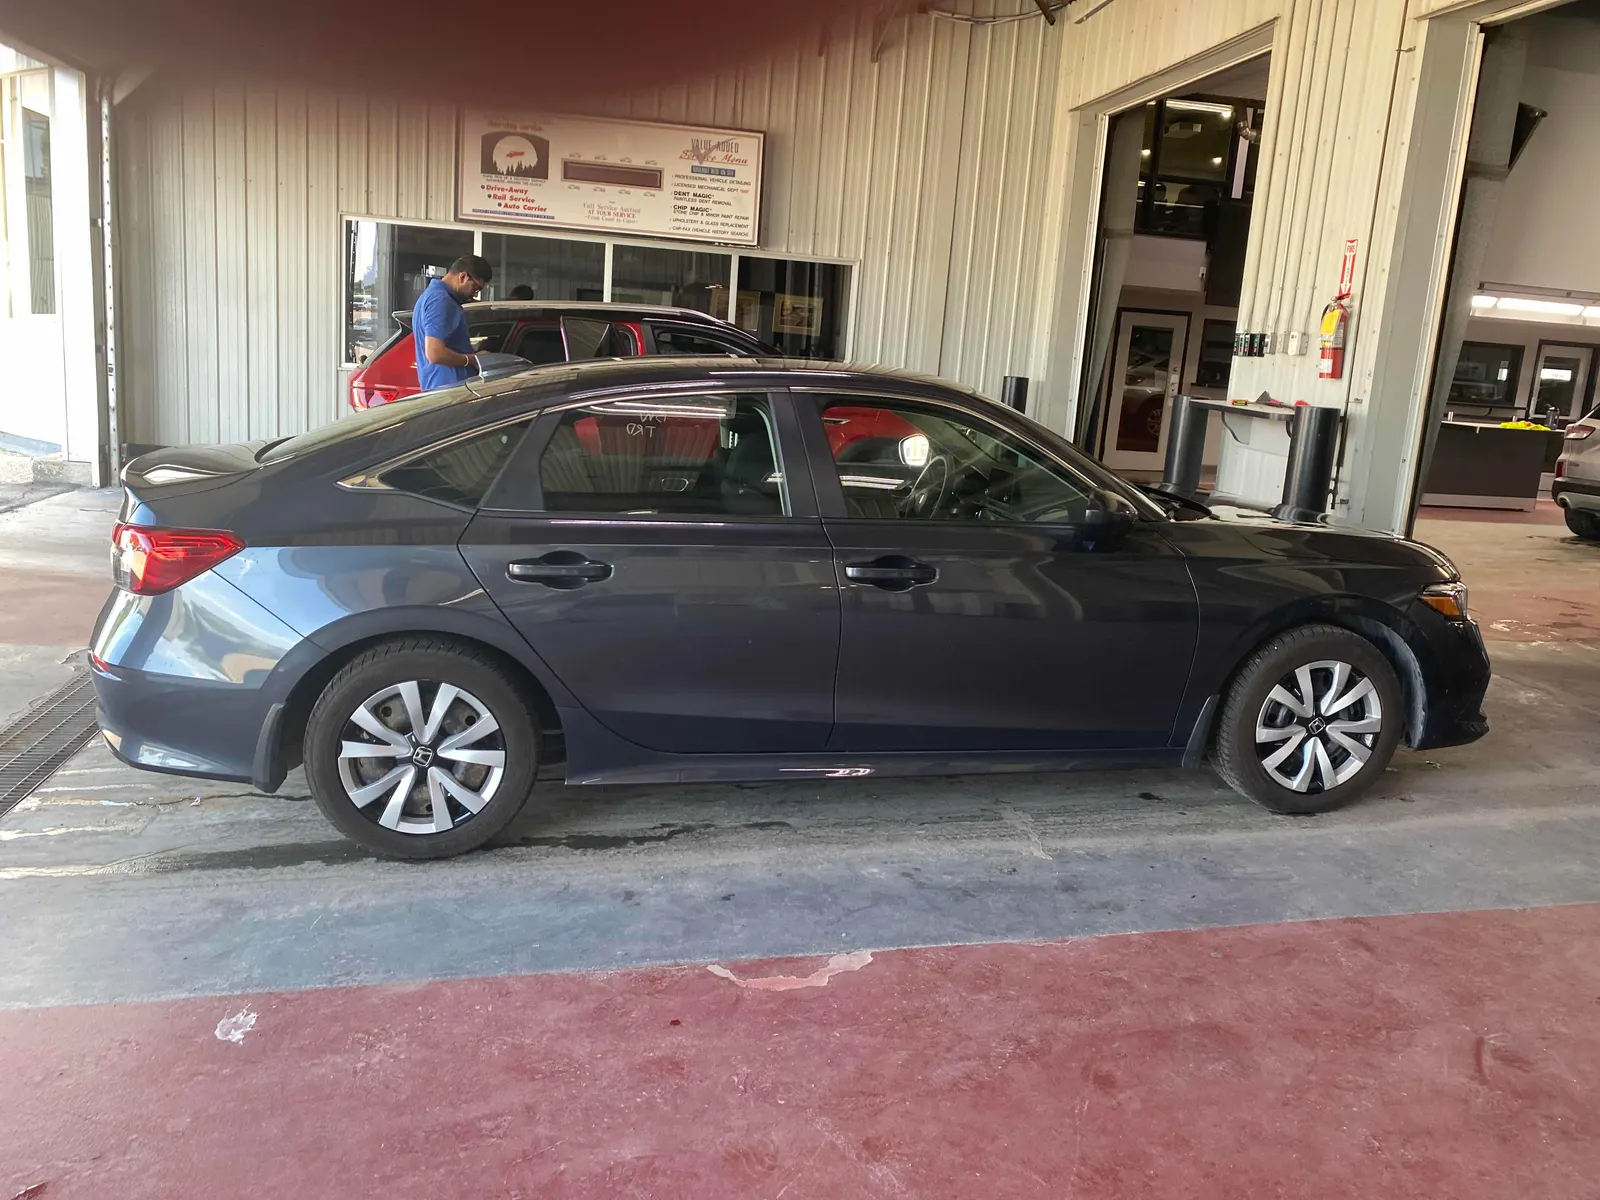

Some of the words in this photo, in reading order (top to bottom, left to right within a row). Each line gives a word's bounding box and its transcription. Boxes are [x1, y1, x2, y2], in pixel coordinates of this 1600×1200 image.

[691, 138, 712, 150] VALUE
[716, 140, 740, 154] ADDED
[680, 149, 716, 160] Serce
[722, 153, 748, 164] Menu
[674, 174, 708, 182] PROFESSIONAL
[486, 185, 528, 195] Drive-Away
[509, 195, 536, 204] Service
